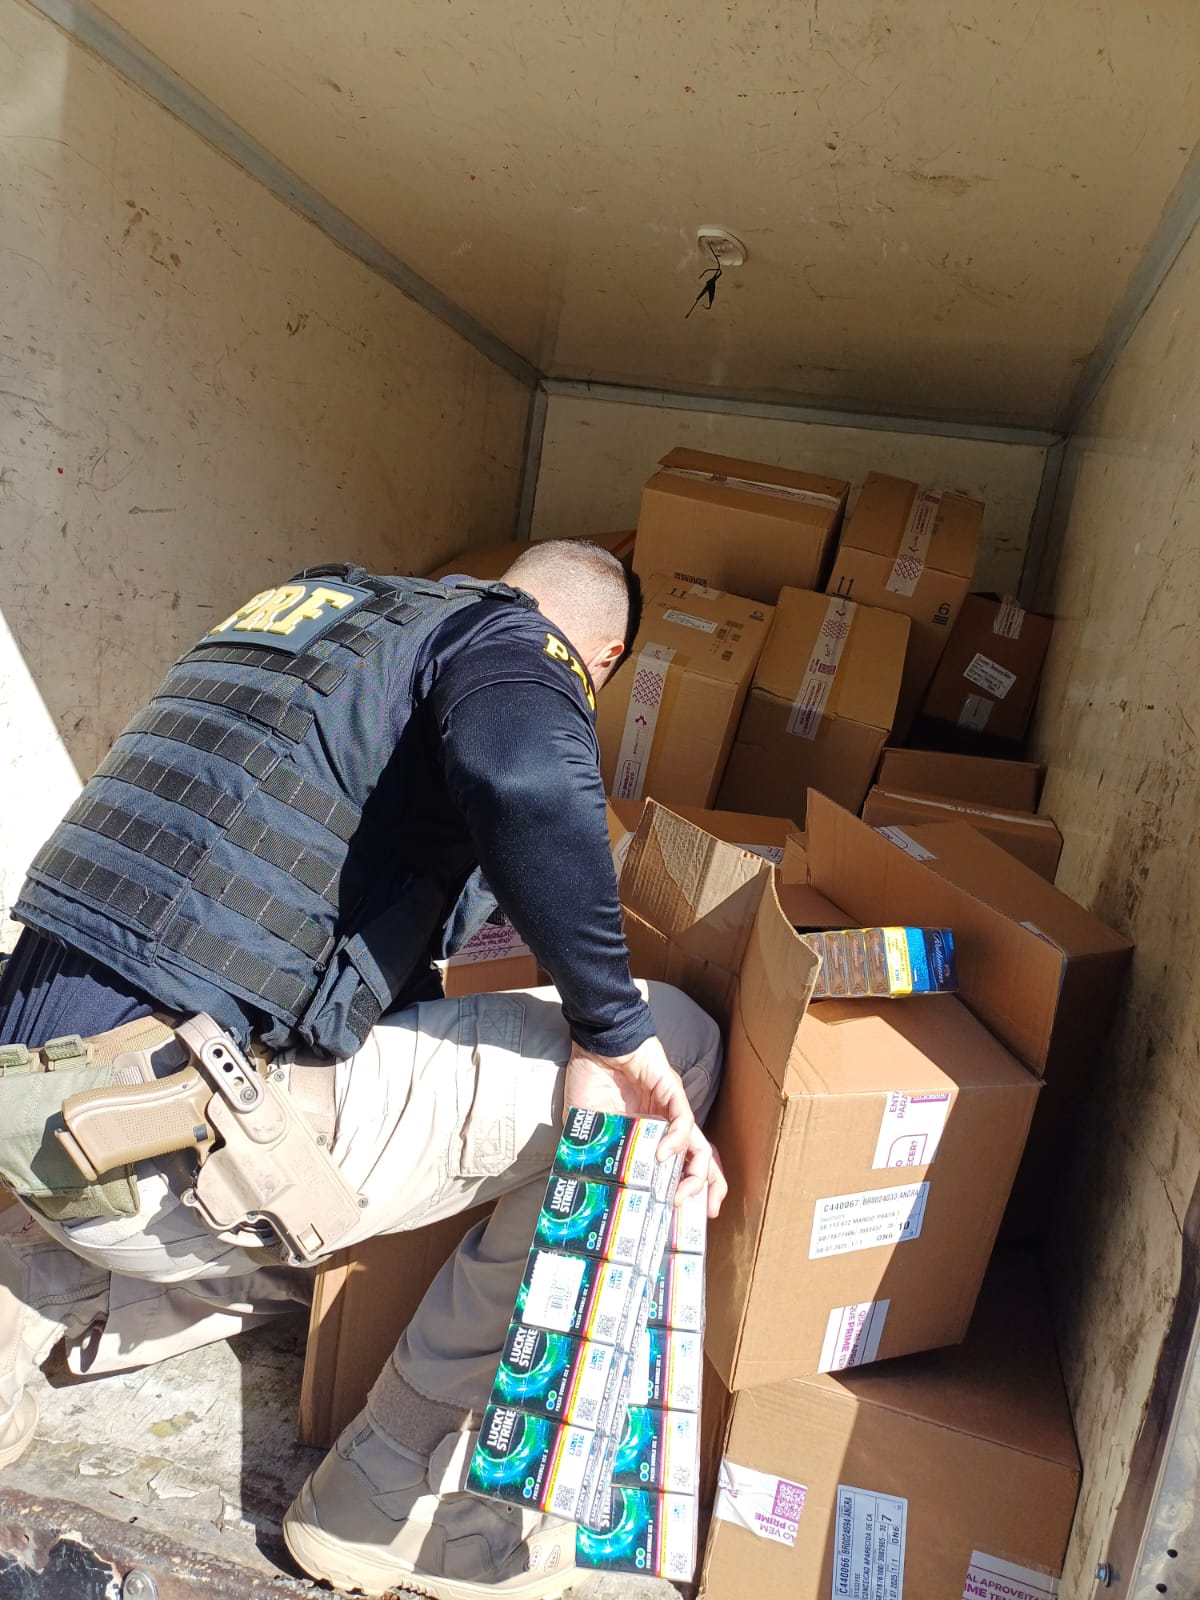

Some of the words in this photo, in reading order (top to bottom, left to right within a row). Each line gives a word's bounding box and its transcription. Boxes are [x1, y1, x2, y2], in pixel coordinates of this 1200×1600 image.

[209, 585, 354, 635] PRF
[932, 933, 945, 984] Rothmans
[570, 1109, 588, 1137] LUCKY
[579, 1110, 596, 1140] STRIKE
[551, 1178, 567, 1209] LUCKY
[560, 1179, 577, 1213] STRIKE
[899, 1221, 910, 1230] 10
[509, 1327, 528, 1362] LUCKY
[519, 1328, 538, 1367] STRIKE
[842, 1322, 855, 1352] PRIME
[487, 1408, 505, 1446] LUCKY
[497, 1410, 516, 1451] STRIKE
[755, 1512, 786, 1530] PRIME
[760, 1523, 781, 1537] VEM
[866, 1522, 872, 1531] DE
[882, 1514, 892, 1522] 7
[839, 1558, 849, 1594] C440066
[844, 1497, 852, 1518] ANGRA
[864, 1533, 872, 1566] APARECIDA
